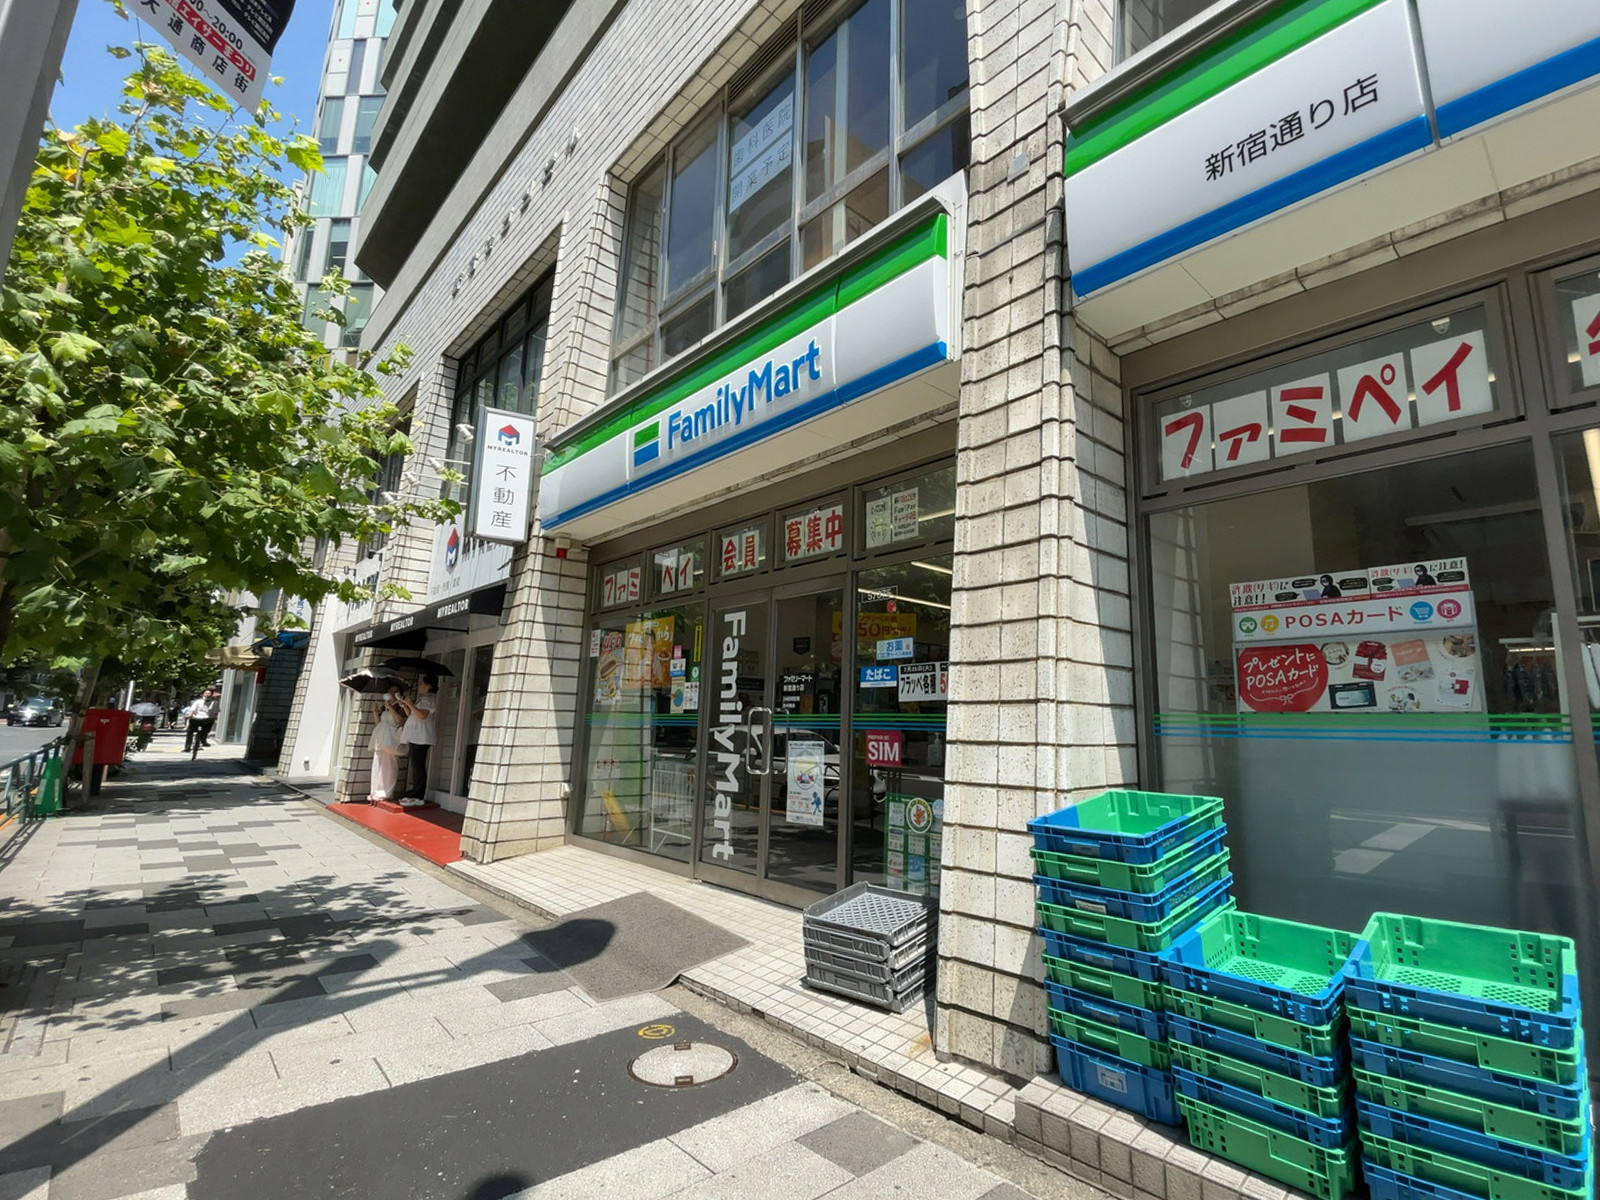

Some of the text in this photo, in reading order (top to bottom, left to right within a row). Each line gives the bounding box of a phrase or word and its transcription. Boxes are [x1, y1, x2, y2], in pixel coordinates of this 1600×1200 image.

[733, 104, 791, 164] 科医院
[1204, 73, 1379, 182] 新宿通り店
[667, 338, 822, 450] FamilyMart
[1164, 341, 1474, 470] ファミペイ
[487, 445, 528, 456] MYREALTOR
[491, 464, 517, 529] 不動産
[603, 570, 641, 605] ファミ
[723, 530, 757, 572] 会員
[786, 509, 843, 558] 募集中
[436, 598, 470, 619] MYREALTOR
[1284, 605, 1404, 630] POSAカード
[1243, 647, 1317, 674] プレゼントに
[865, 668, 892, 681] たばこ
[900, 673, 937, 695] フラッペ各種
[1245, 664, 1319, 691] POSAカード
[711, 610, 747, 861] FamilyMart
[868, 741, 900, 762] SIM
